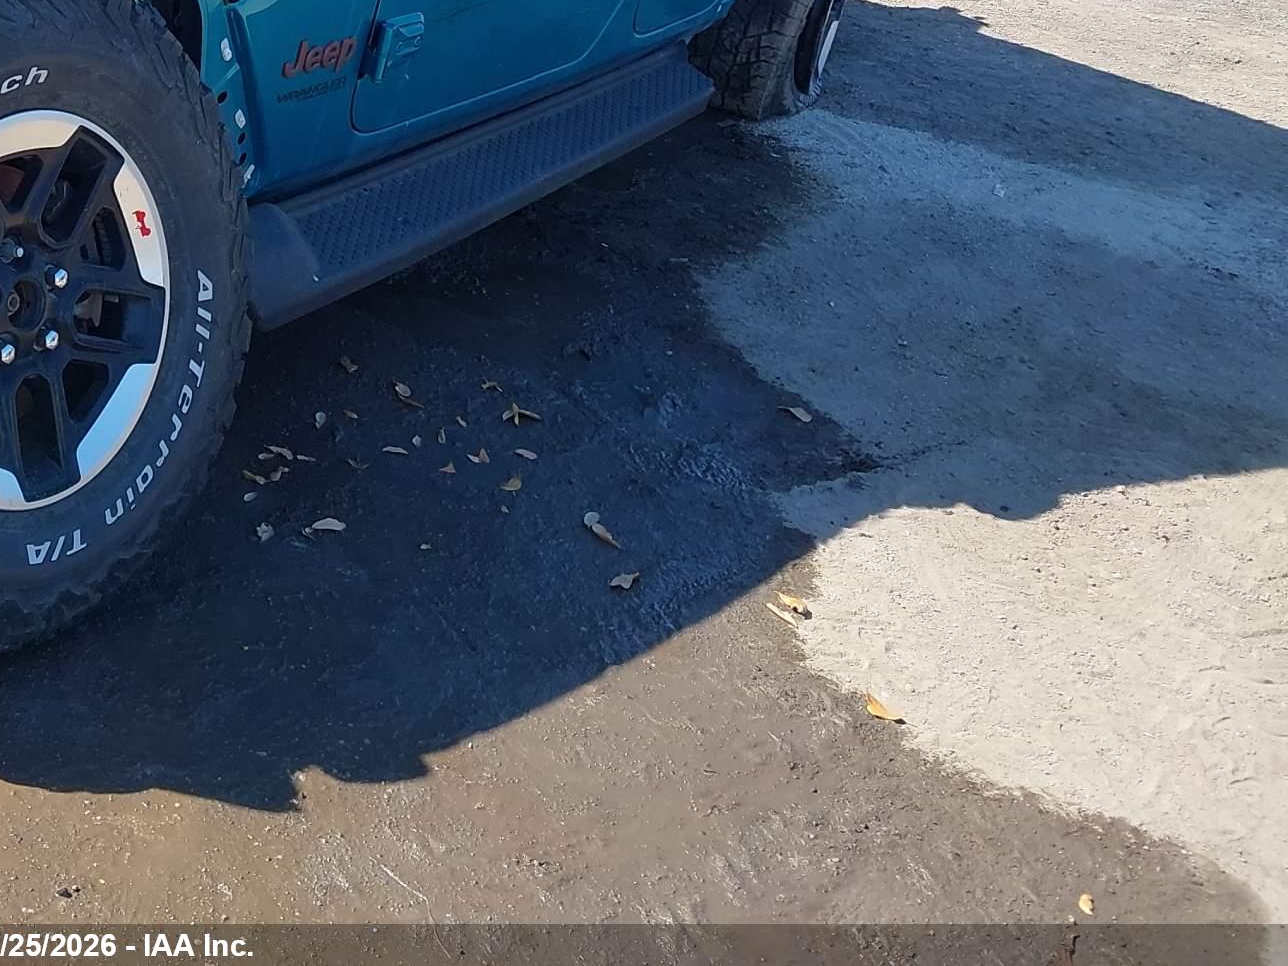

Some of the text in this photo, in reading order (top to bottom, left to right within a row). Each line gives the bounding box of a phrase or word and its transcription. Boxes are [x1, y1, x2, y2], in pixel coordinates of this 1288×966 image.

[281, 35, 356, 78] Jeep
[25, 269, 214, 565] All-Terrain T/A
